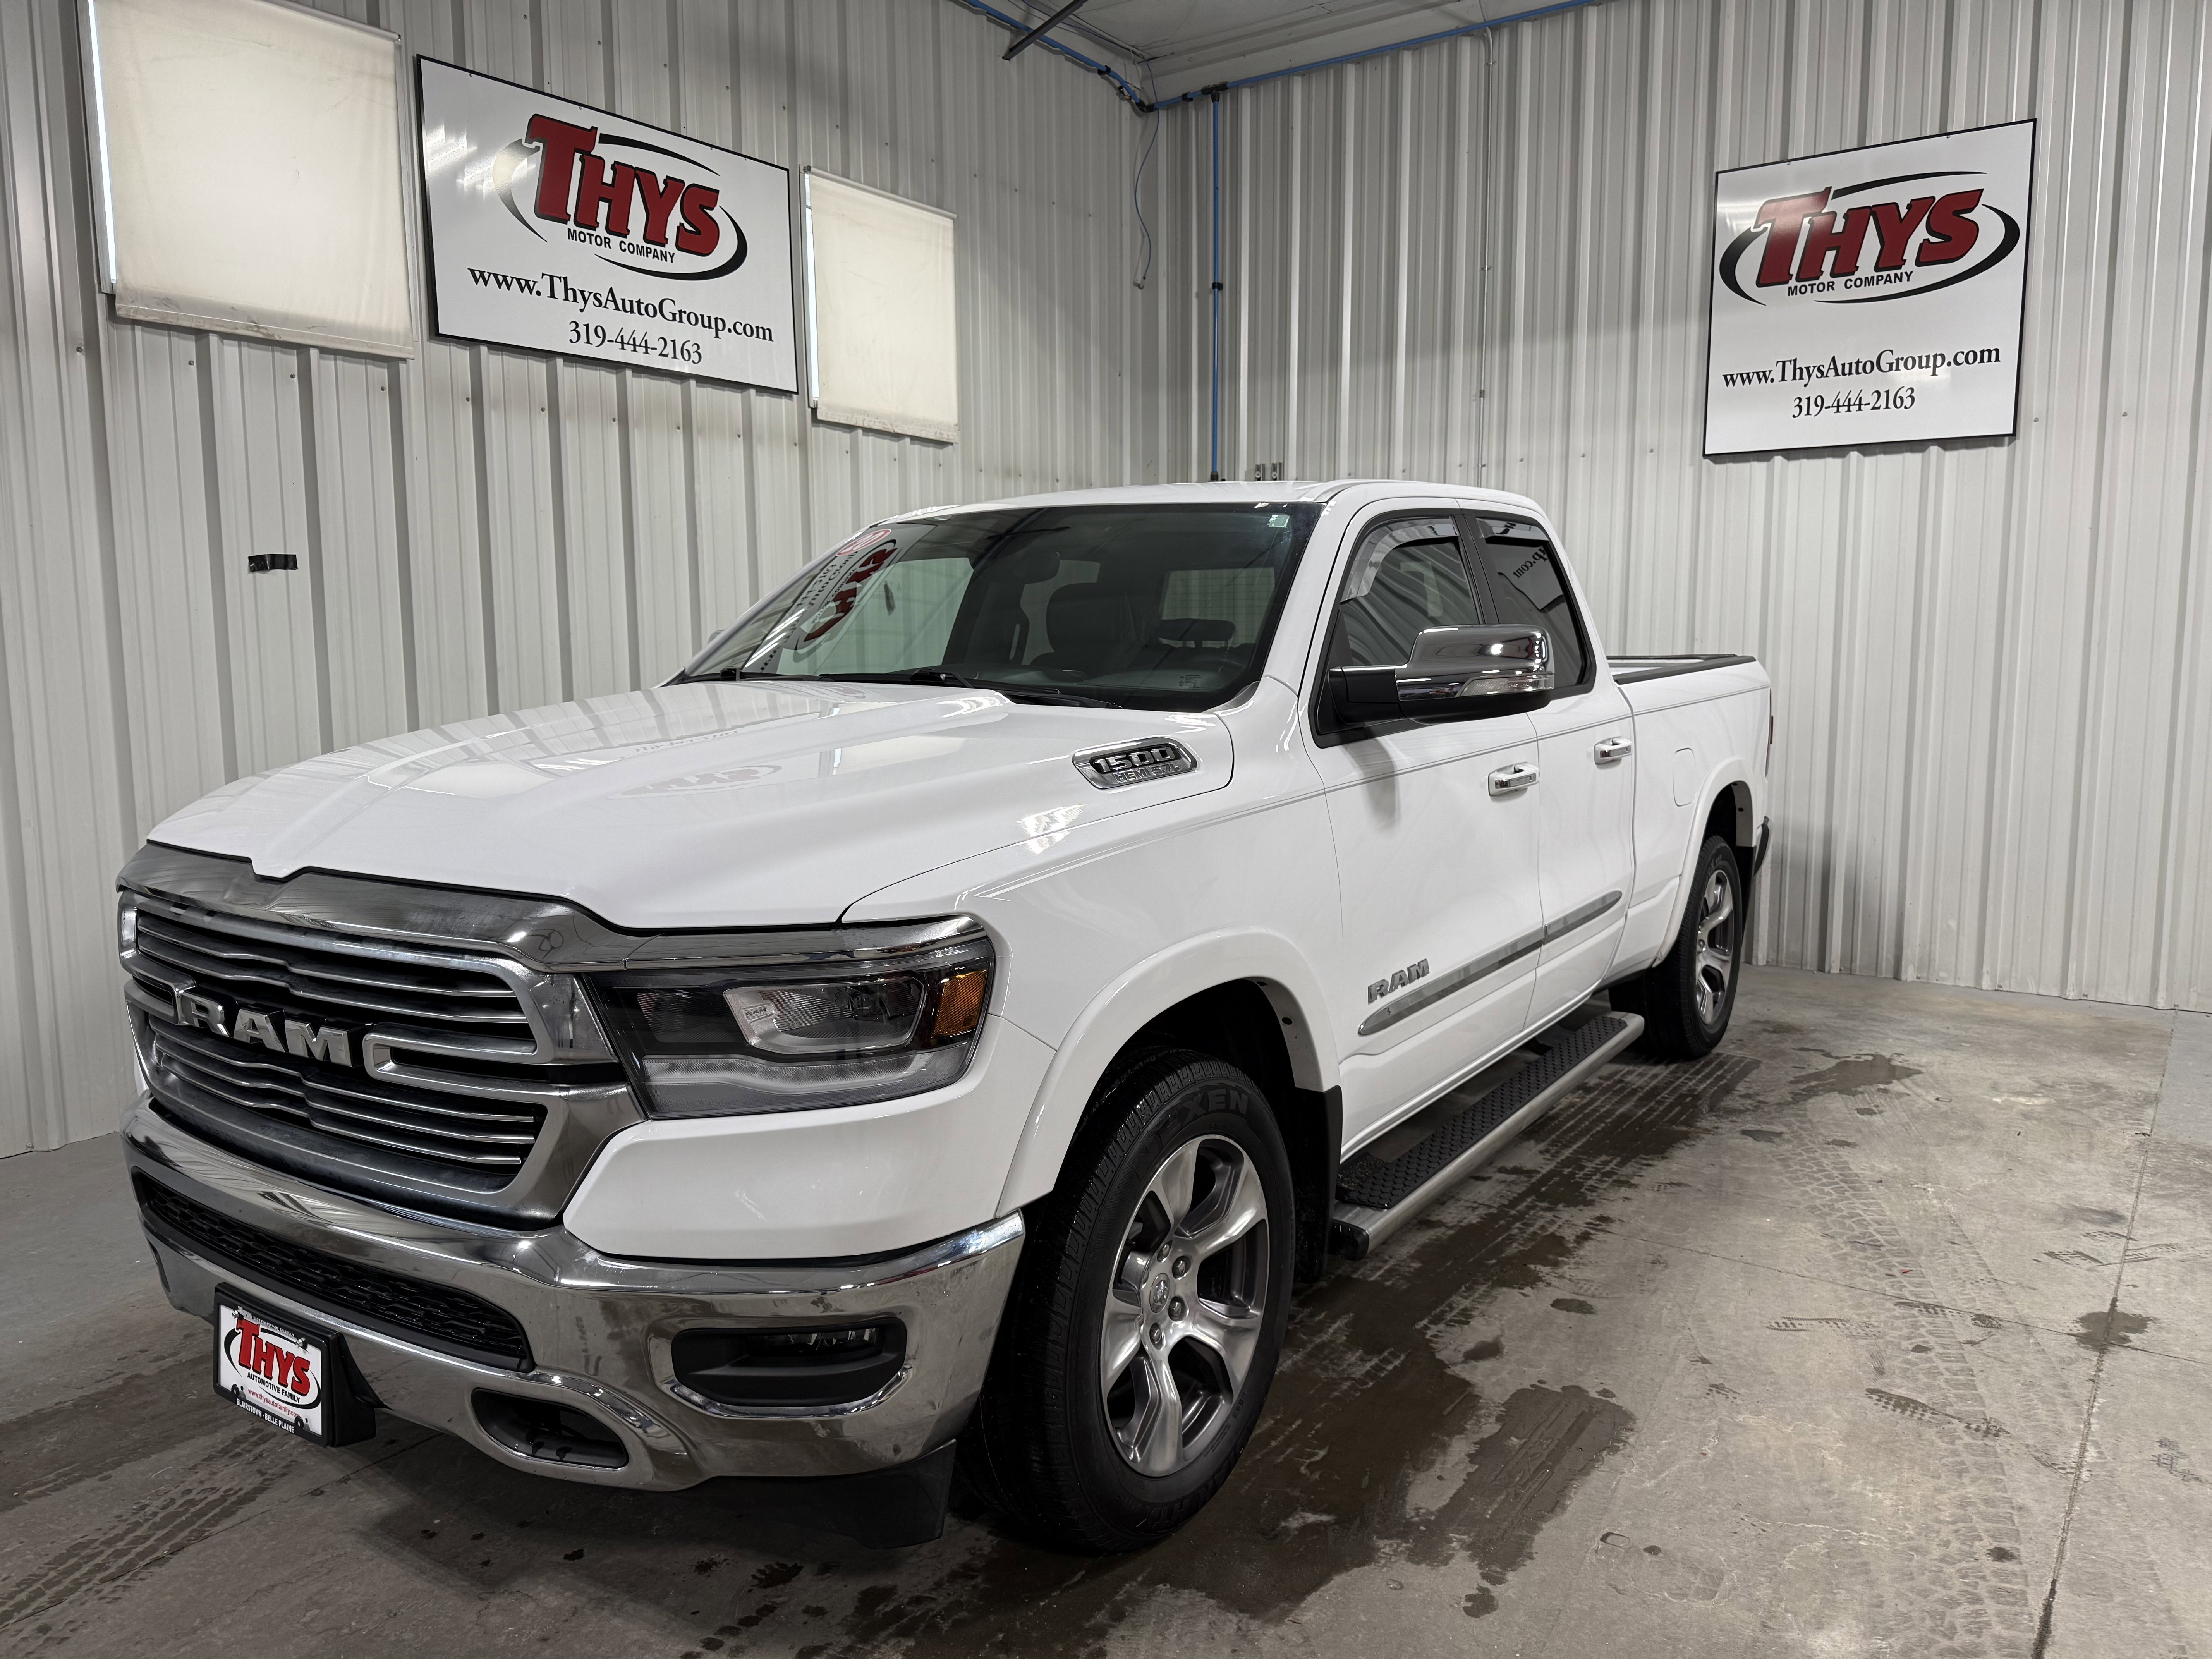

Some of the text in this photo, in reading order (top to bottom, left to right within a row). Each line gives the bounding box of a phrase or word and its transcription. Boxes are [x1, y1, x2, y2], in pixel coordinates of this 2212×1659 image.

[524, 113, 720, 257] THYS
[567, 228, 675, 263] MOTOR COMPANY
[1754, 186, 1984, 287] THYS
[467, 267, 773, 342] www.ThysAutoGroup.com
[1787, 271, 1913, 297] MOTOR COMPANY
[569, 321, 702, 365] 319-444-2163
[1722, 347, 2001, 387] www.ThysAutoGroup.com
[1792, 386, 1915, 418] 319-444-2163
[1093, 747, 1175, 773] 1500
[1367, 958, 1430, 1005] RAM
[181, 990, 353, 1067] RAM
[236, 1317, 310, 1397] THYS
[247, 1372, 300, 1403] AUTOMOTIVE FAMILY
[237, 1398, 295, 1434] BLAIRSTOWN BELLE PLAINE
